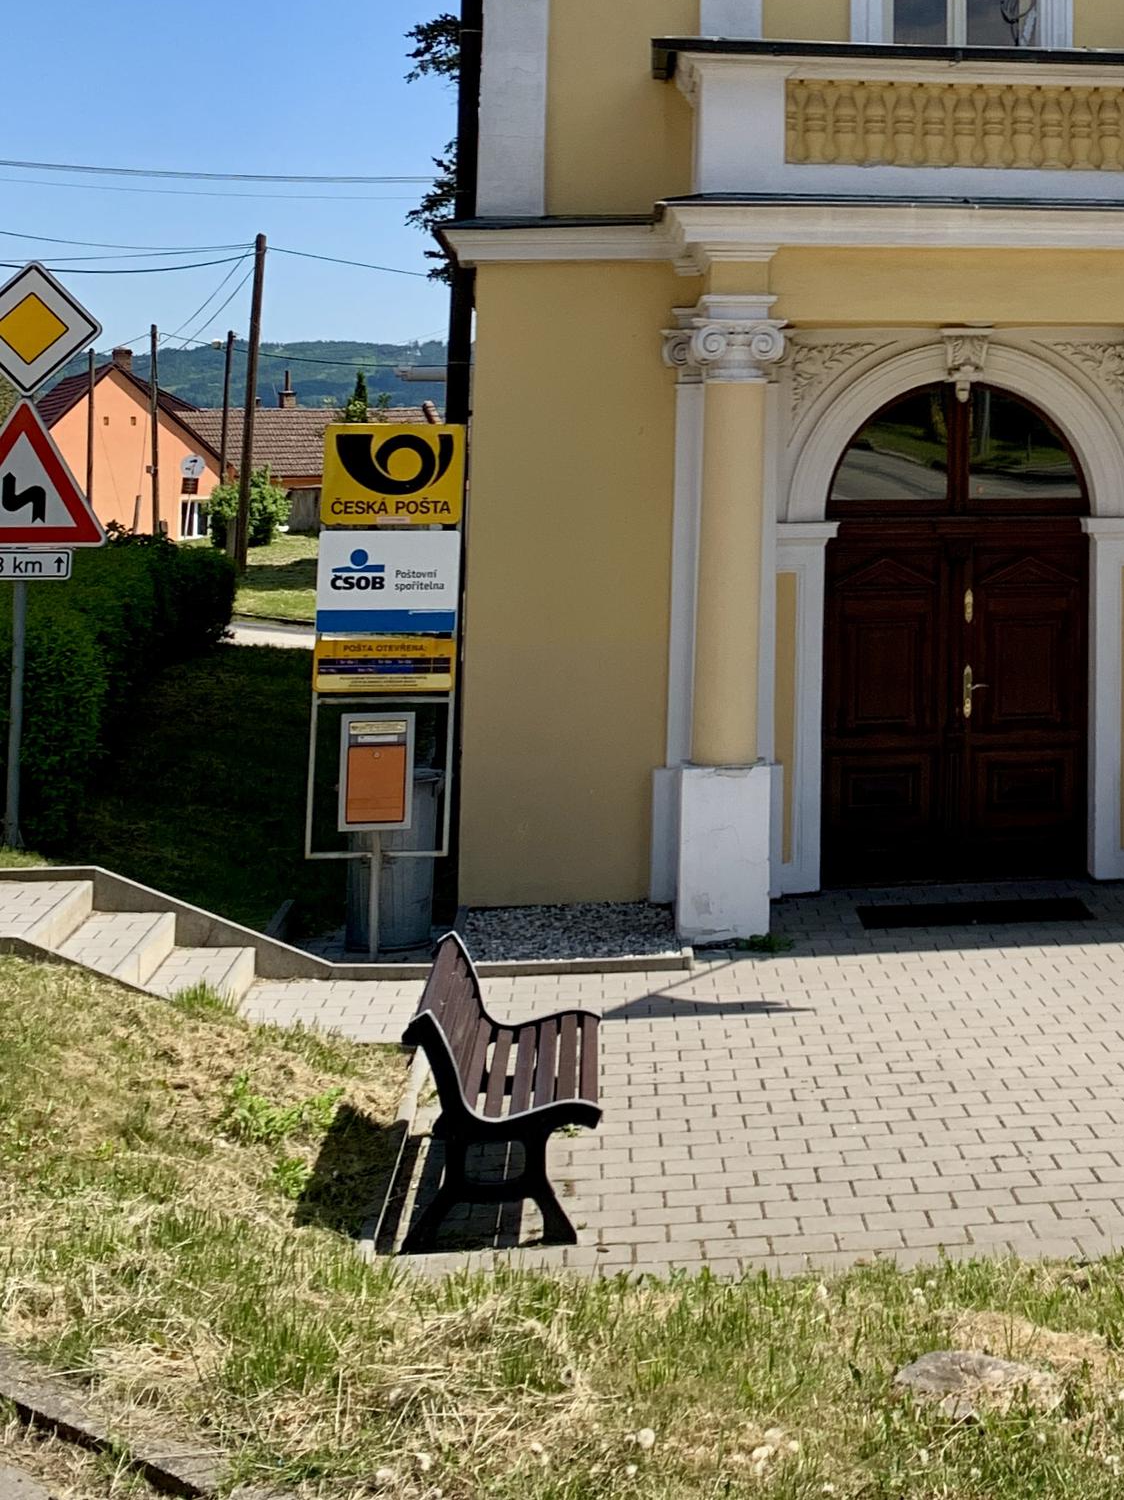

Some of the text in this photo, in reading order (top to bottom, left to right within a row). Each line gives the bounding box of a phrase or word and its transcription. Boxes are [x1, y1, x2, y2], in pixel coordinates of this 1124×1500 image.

[331, 498, 451, 515] ČESKÁ POŠTA
[13, 556, 42, 573] km
[395, 569, 438, 579] Poštovní
[331, 574, 385, 590] ČSOB
[395, 581, 445, 592] spořitelna
[343, 643, 373, 653] POŠTA
